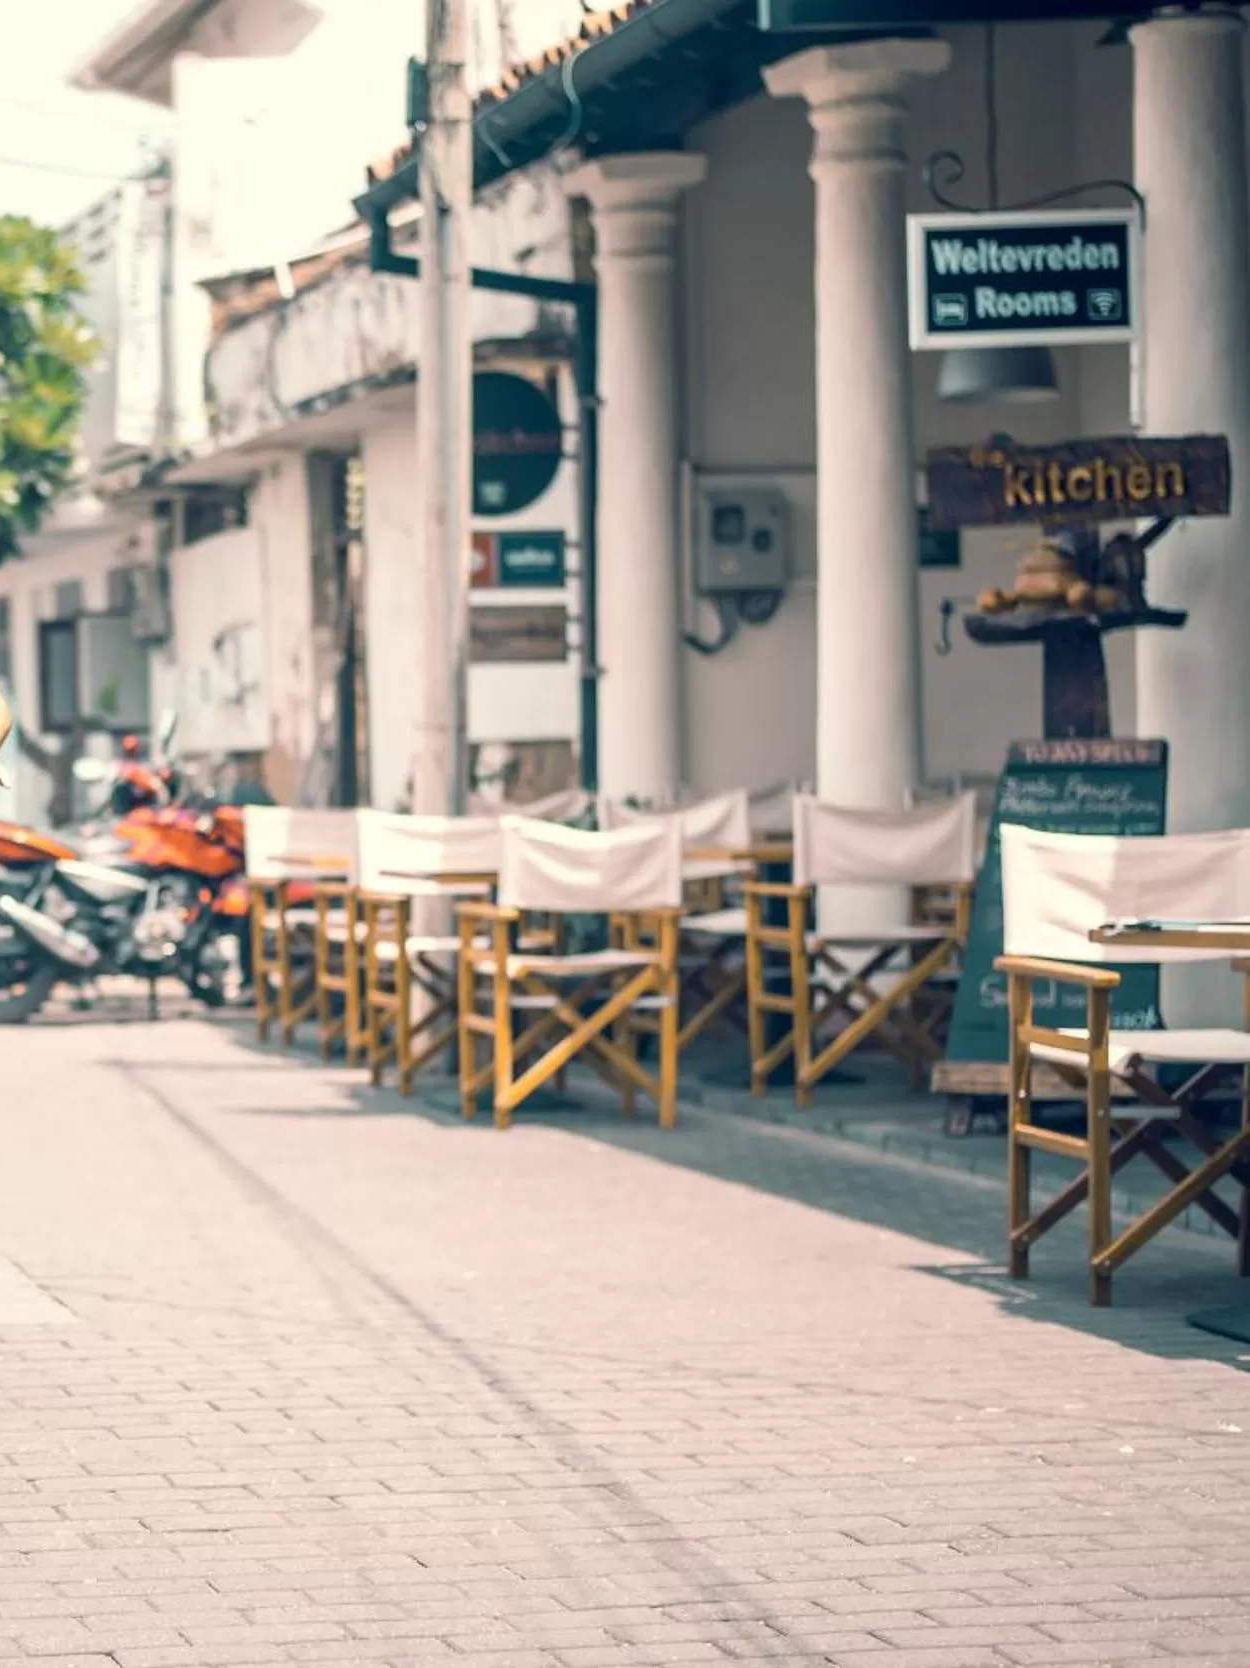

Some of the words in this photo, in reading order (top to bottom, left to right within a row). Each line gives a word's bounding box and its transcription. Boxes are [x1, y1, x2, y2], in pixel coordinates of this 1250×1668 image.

[931, 236, 1119, 275] Weltevreden
[975, 286, 1078, 319] Rooms
[1003, 459, 1185, 507] kitchen
